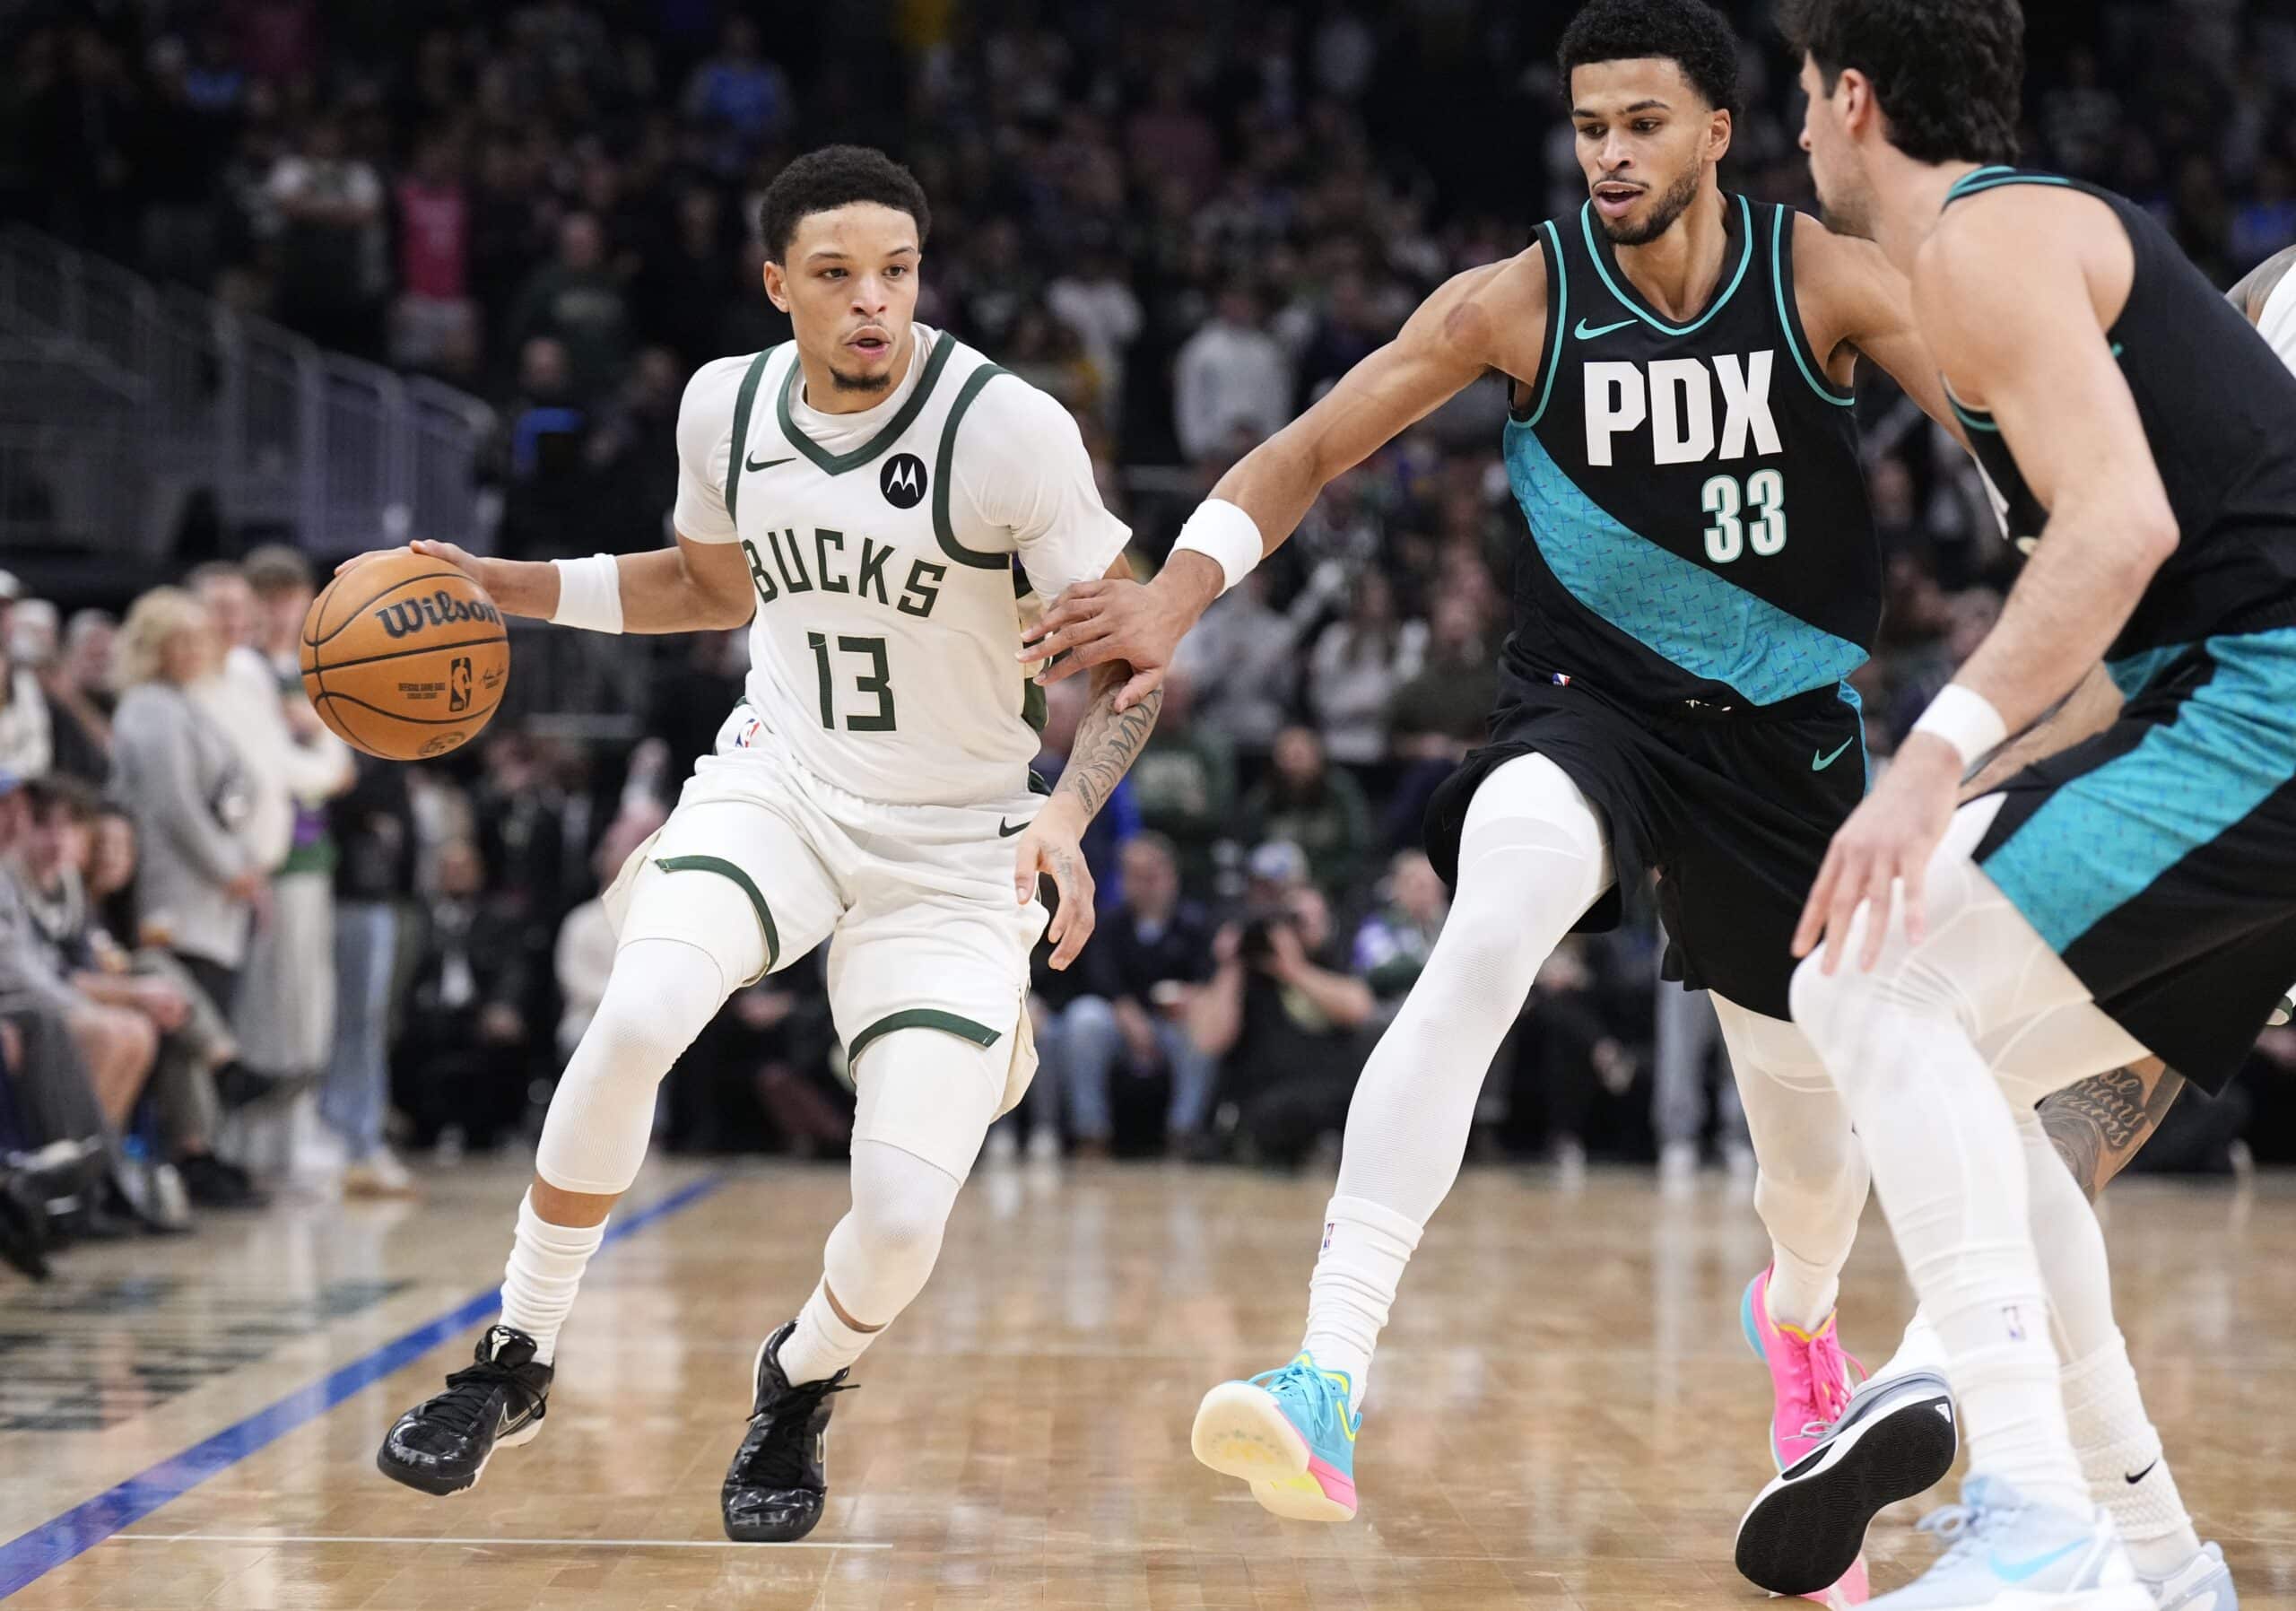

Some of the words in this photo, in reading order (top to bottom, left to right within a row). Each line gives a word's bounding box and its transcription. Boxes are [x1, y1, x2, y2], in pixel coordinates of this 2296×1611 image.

[1583, 349, 1783, 466] PDX
[1701, 468, 1787, 564] 33
[374, 589, 502, 640] Wilson
[742, 527, 948, 618] BUCKS
[807, 631, 897, 732] 13
